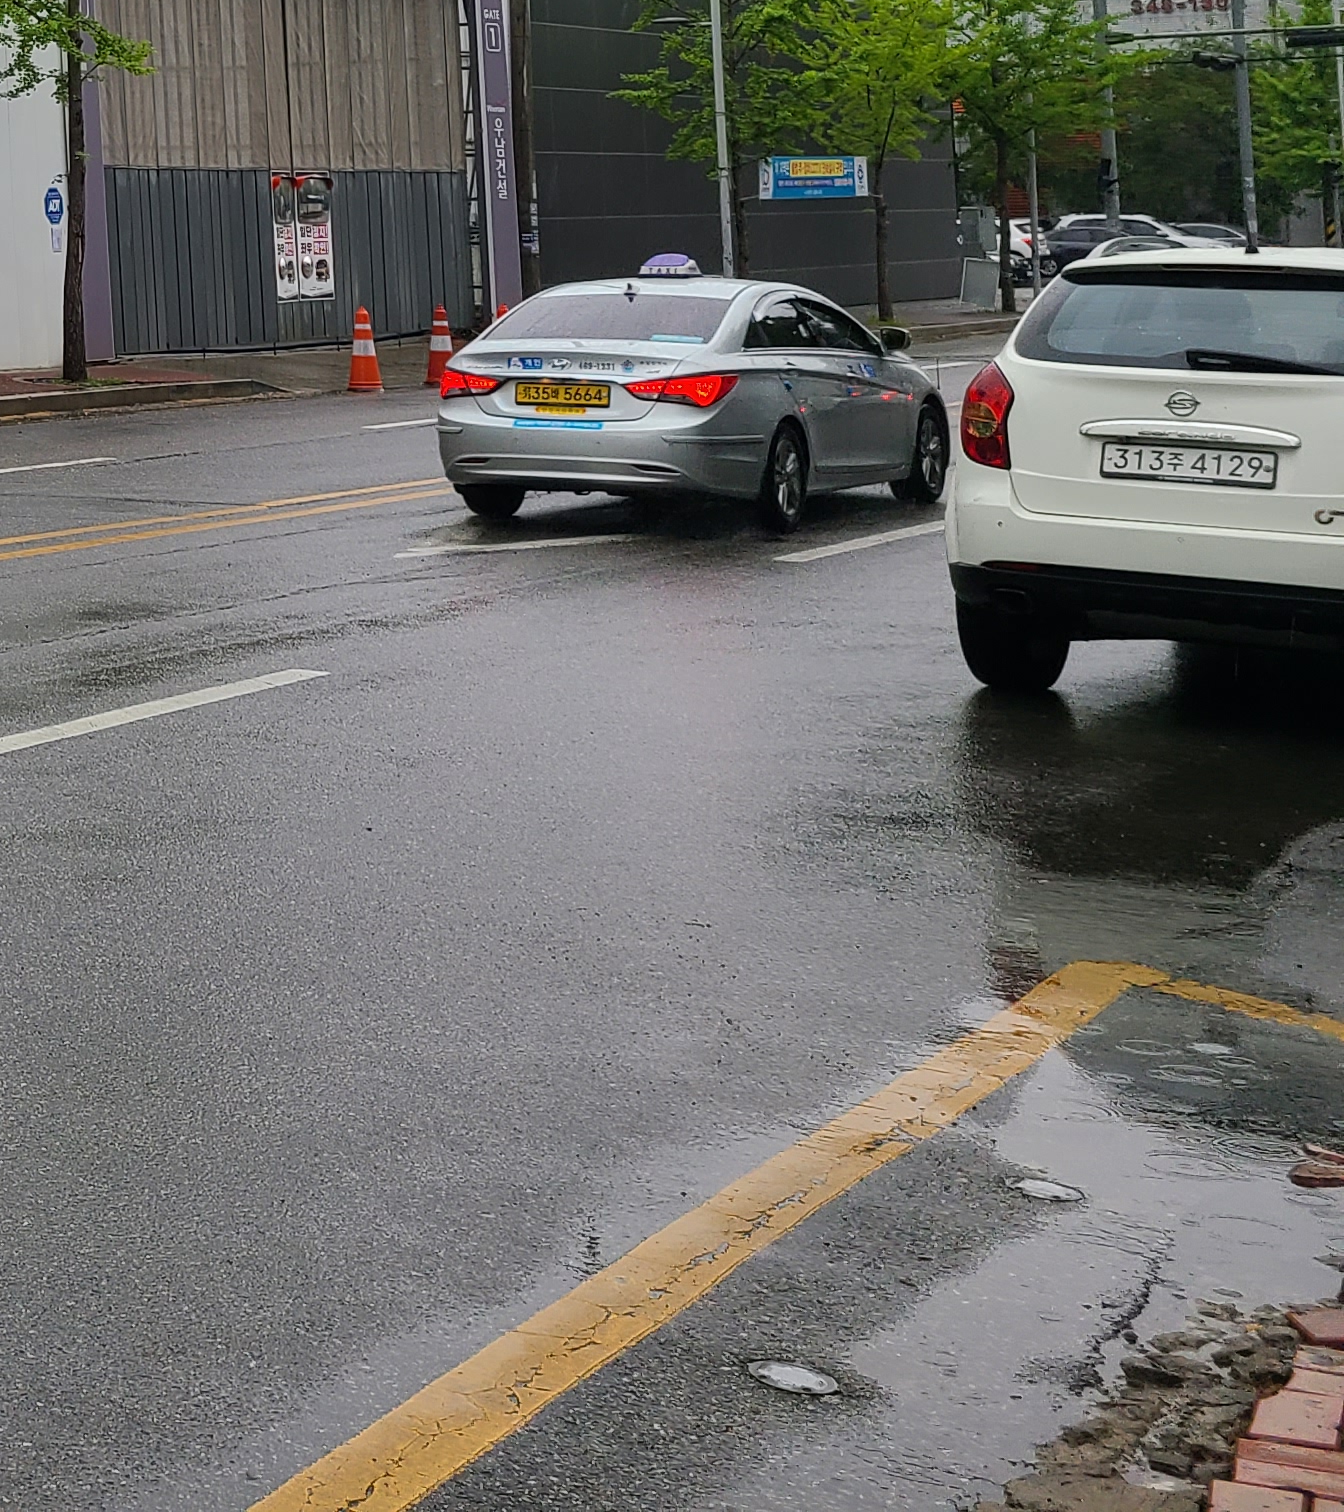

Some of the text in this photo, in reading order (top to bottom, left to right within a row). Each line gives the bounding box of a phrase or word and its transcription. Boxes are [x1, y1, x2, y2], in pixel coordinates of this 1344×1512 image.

[484, 9, 500, 20] GATE
[489, 27, 497, 47] 1
[493, 118, 508, 200] 우남건설
[48, 199, 60, 213] ADT
[564, 387, 603, 402] 5664
[1114, 449, 1264, 478] 313주 4129
